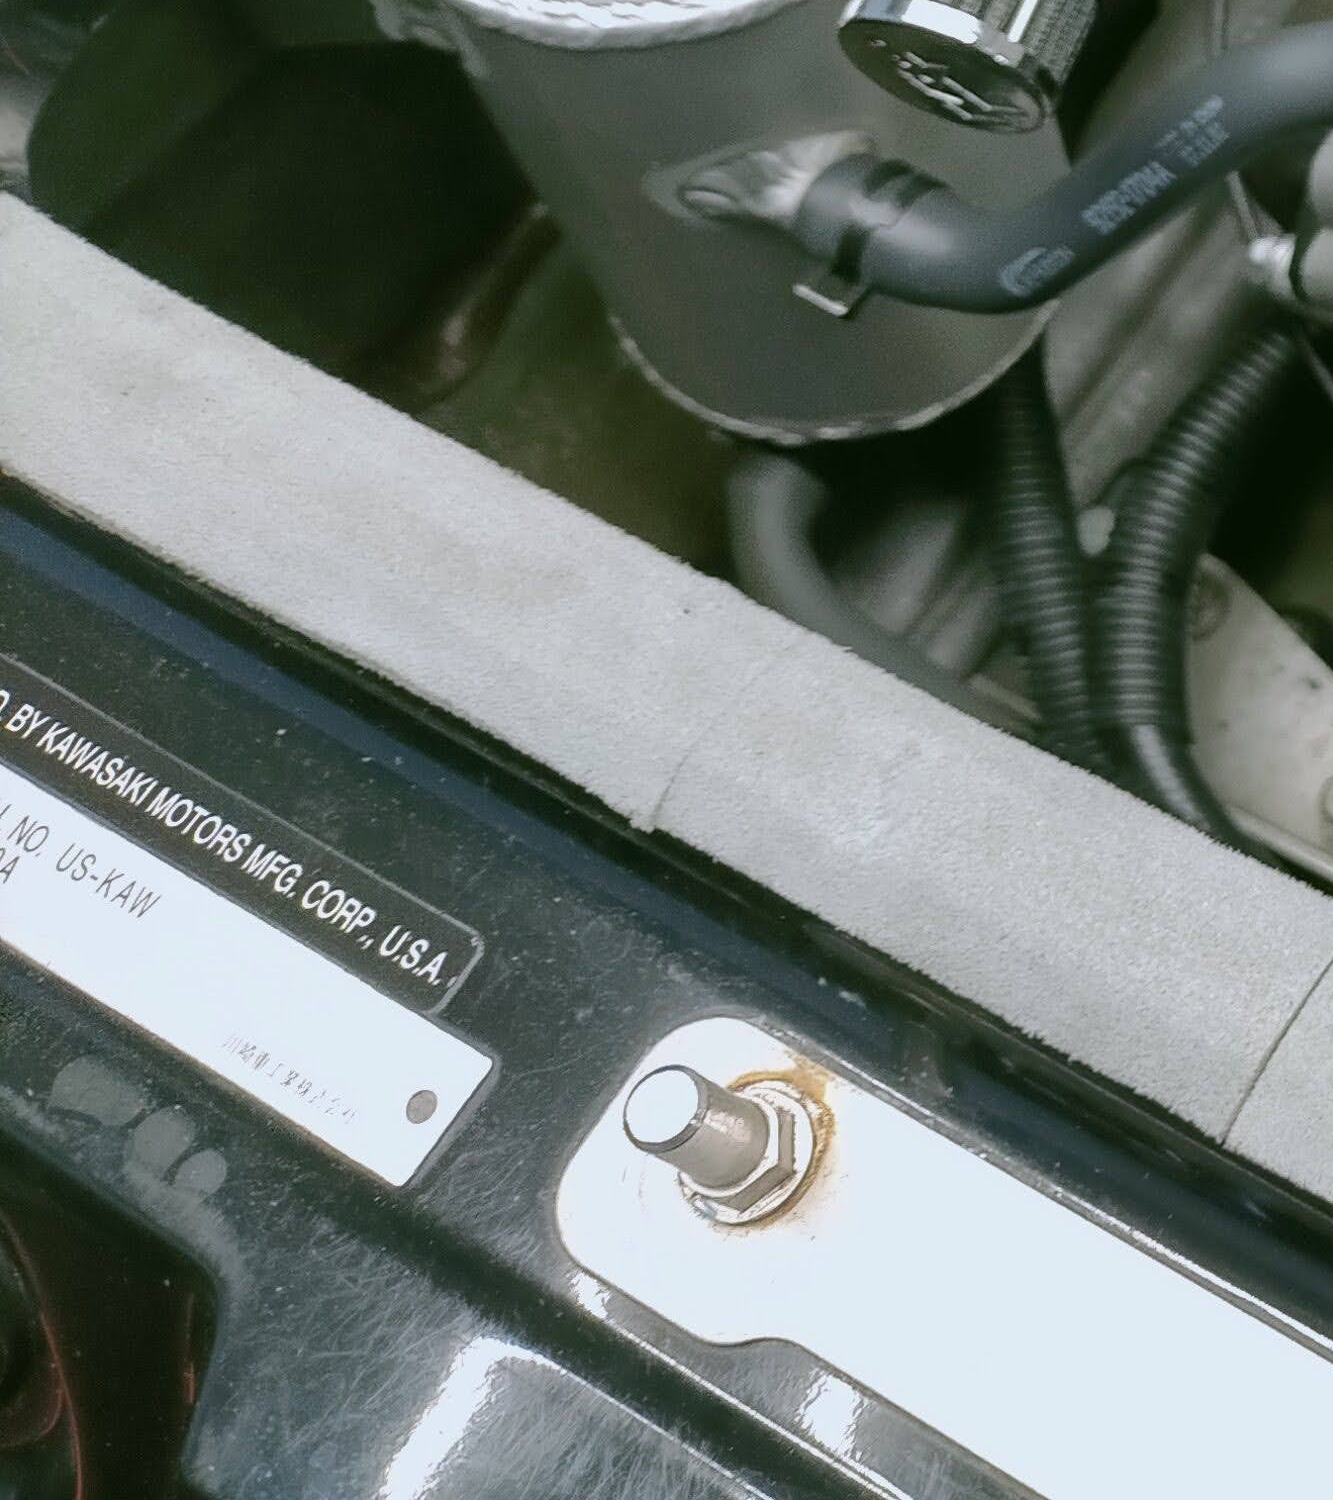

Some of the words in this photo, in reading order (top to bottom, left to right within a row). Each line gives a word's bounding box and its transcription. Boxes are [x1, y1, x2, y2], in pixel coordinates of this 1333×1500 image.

[4, 703, 51, 739] BY
[36, 721, 160, 807] KAWASAKI
[145, 786, 251, 863] MOTORS
[240, 843, 303, 899] MFG.
[56, 843, 162, 918] US-KAW
